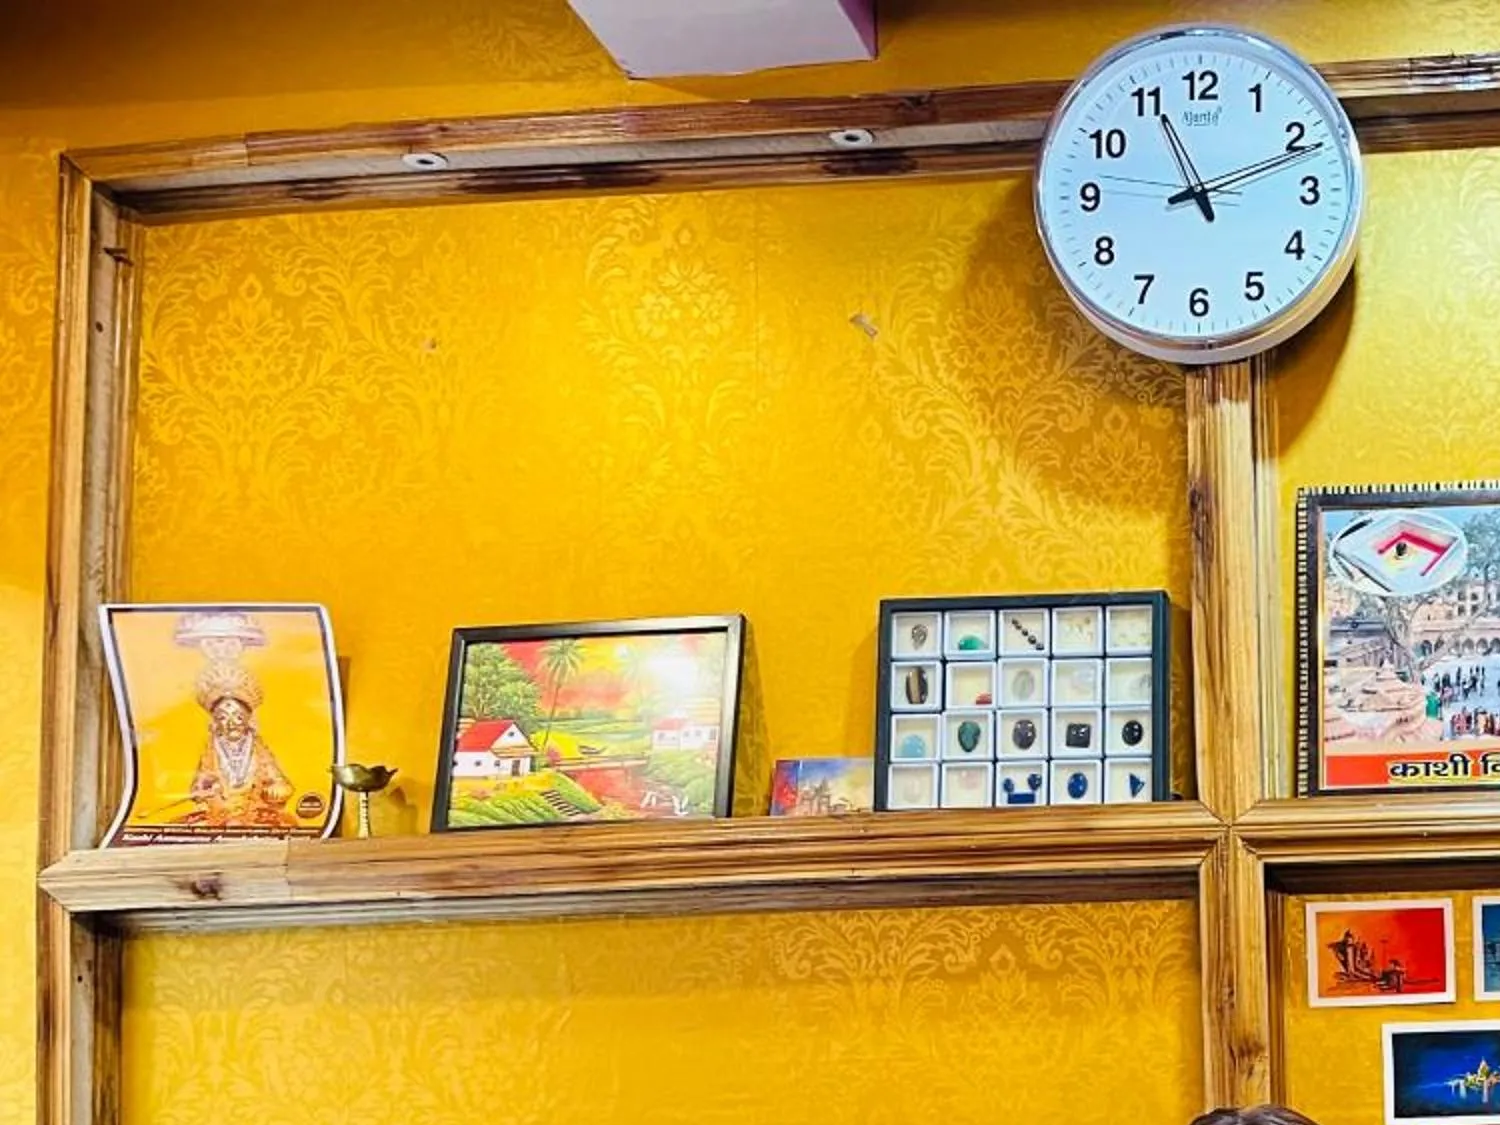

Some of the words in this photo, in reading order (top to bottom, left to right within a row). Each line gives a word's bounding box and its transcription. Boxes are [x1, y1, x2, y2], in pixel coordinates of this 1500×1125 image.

[1182, 70, 1218, 100] 12
[1249, 83, 1262, 112] 1
[1131, 87, 1162, 116] 11
[1089, 128, 1126, 159] 10
[1285, 122, 1305, 152] 2
[1080, 183, 1101, 212] 9
[1300, 176, 1321, 205] 3
[1094, 237, 1115, 266] 8
[1285, 230, 1305, 260] 4
[1134, 274, 1155, 304] 7
[1244, 272, 1265, 301] 5
[1189, 288, 1209, 317] 6
[1389, 753, 1469, 778] काशी
